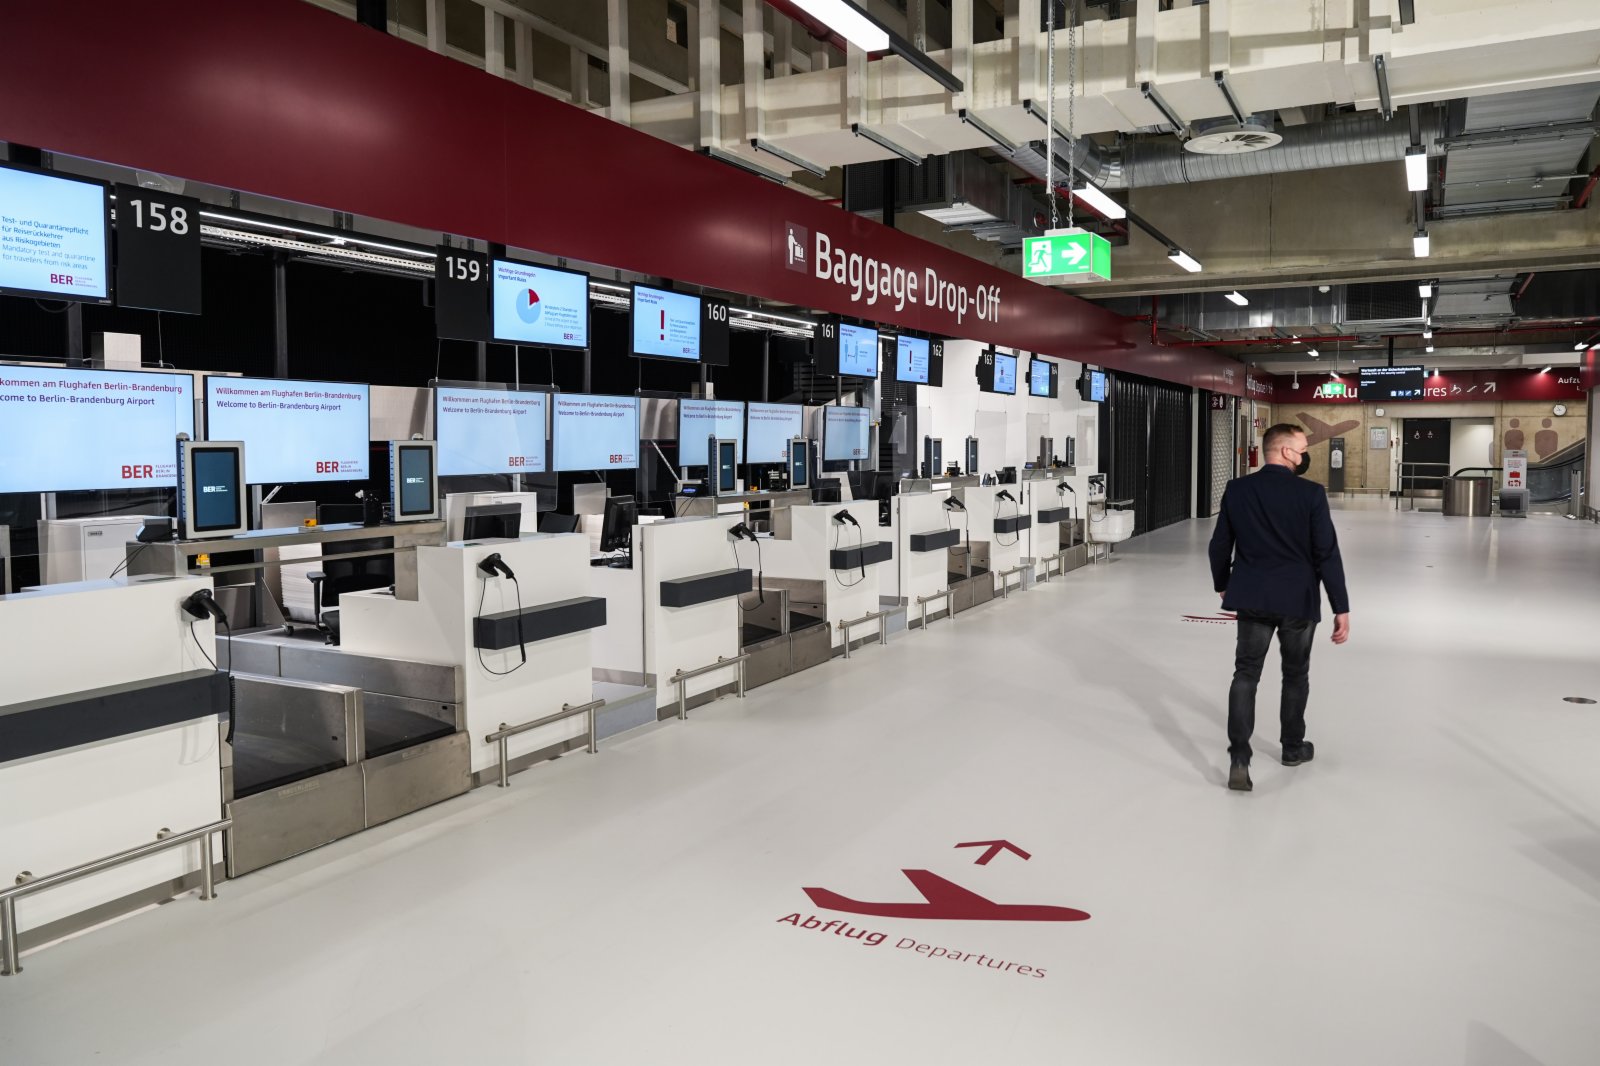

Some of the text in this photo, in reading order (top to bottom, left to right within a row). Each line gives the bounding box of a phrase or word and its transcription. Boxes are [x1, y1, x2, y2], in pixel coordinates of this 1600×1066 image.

[130, 199, 189, 235] 158
[14, 227, 64, 240] Reiserückkehrer
[34, 220, 88, 235] Quarantänepflicht
[15, 236, 60, 248] Risikogebieten
[2, 244, 36, 255] Mandatory
[64, 254, 96, 262] quarantine
[14, 256, 42, 264] travellers
[445, 256, 480, 282] 159
[50, 273, 74, 286] BER
[815, 231, 1000, 324] Baggage Drop-Off
[707, 302, 726, 322] 160
[564, 332, 574, 340] BER
[822, 323, 834, 338] 161
[932, 344, 942, 357] 162
[984, 354, 993, 366] 163
[58, 380, 102, 390] Flughafen
[104, 382, 182, 394] Berlin-Brandenburg
[216, 387, 259, 396] Willkommen
[272, 390, 303, 398] Flughafen
[304, 391, 362, 400] Berlin-Brandenburg
[40, 394, 125, 406] Berlin-Brandenburg
[126, 397, 155, 406] Airport
[258, 402, 320, 411] Berlin-Brandenburg
[508, 456, 524, 467] BER
[609, 454, 622, 463] BER
[122, 464, 153, 479] BER
[316, 461, 339, 473] BER
[776, 912, 1047, 979] Abflug Departures
